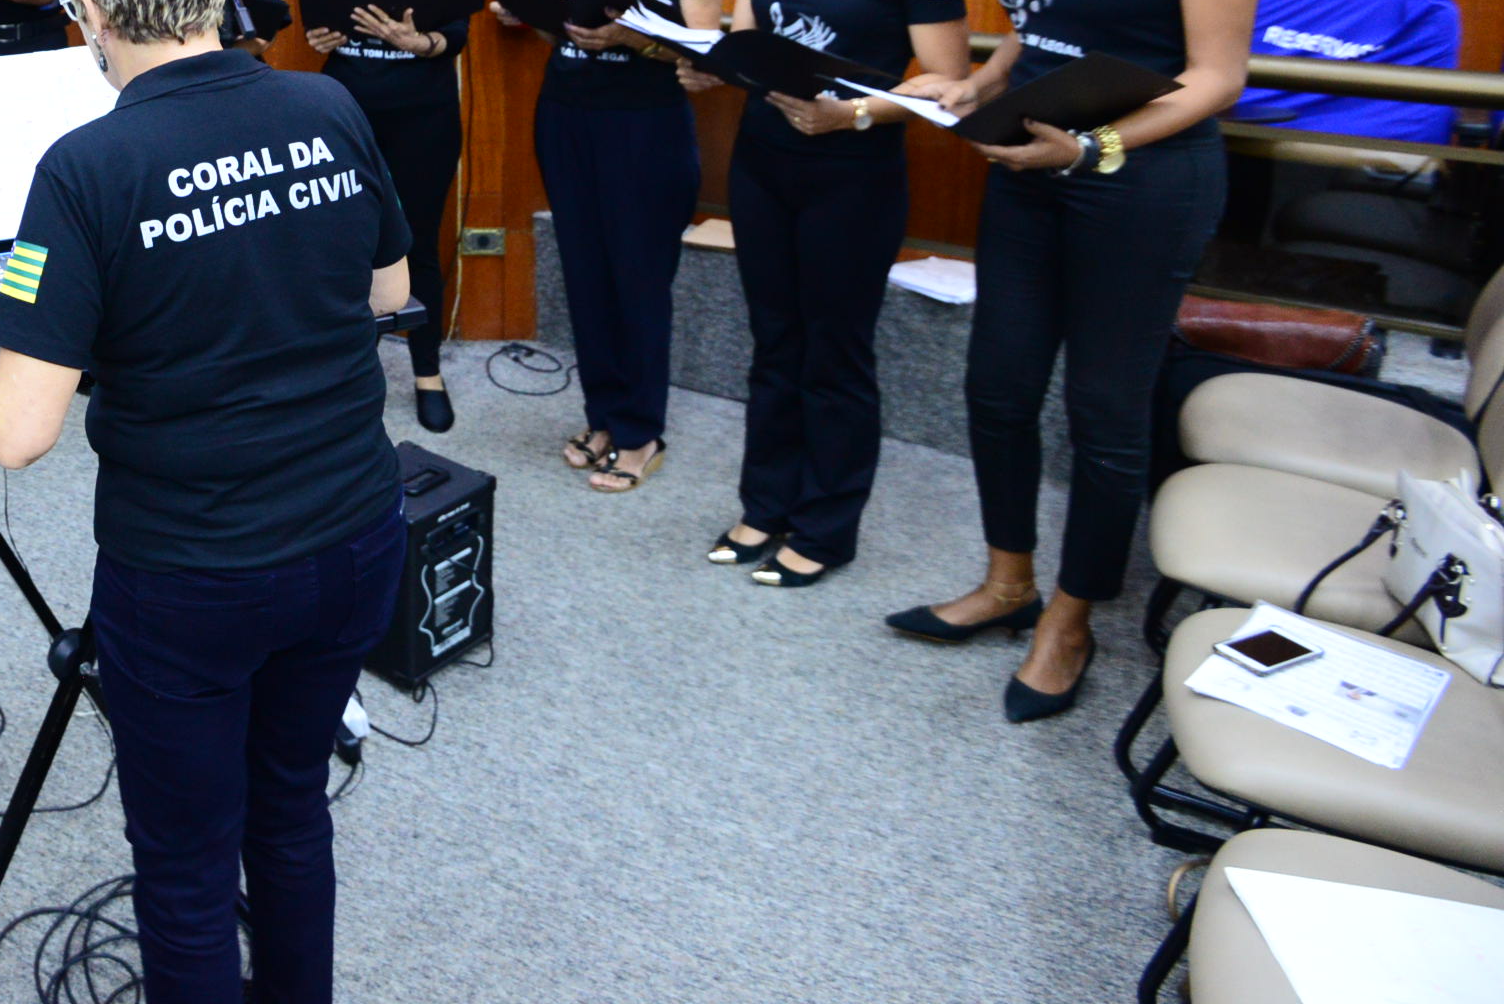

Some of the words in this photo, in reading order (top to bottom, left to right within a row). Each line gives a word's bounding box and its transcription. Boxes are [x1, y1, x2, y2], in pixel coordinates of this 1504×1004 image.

[362, 48, 384, 59] TOM
[167, 147, 284, 198] CORAL
[288, 137, 335, 170] DA
[139, 189, 281, 249] POLÍCIA
[288, 169, 363, 210] CIVIL
